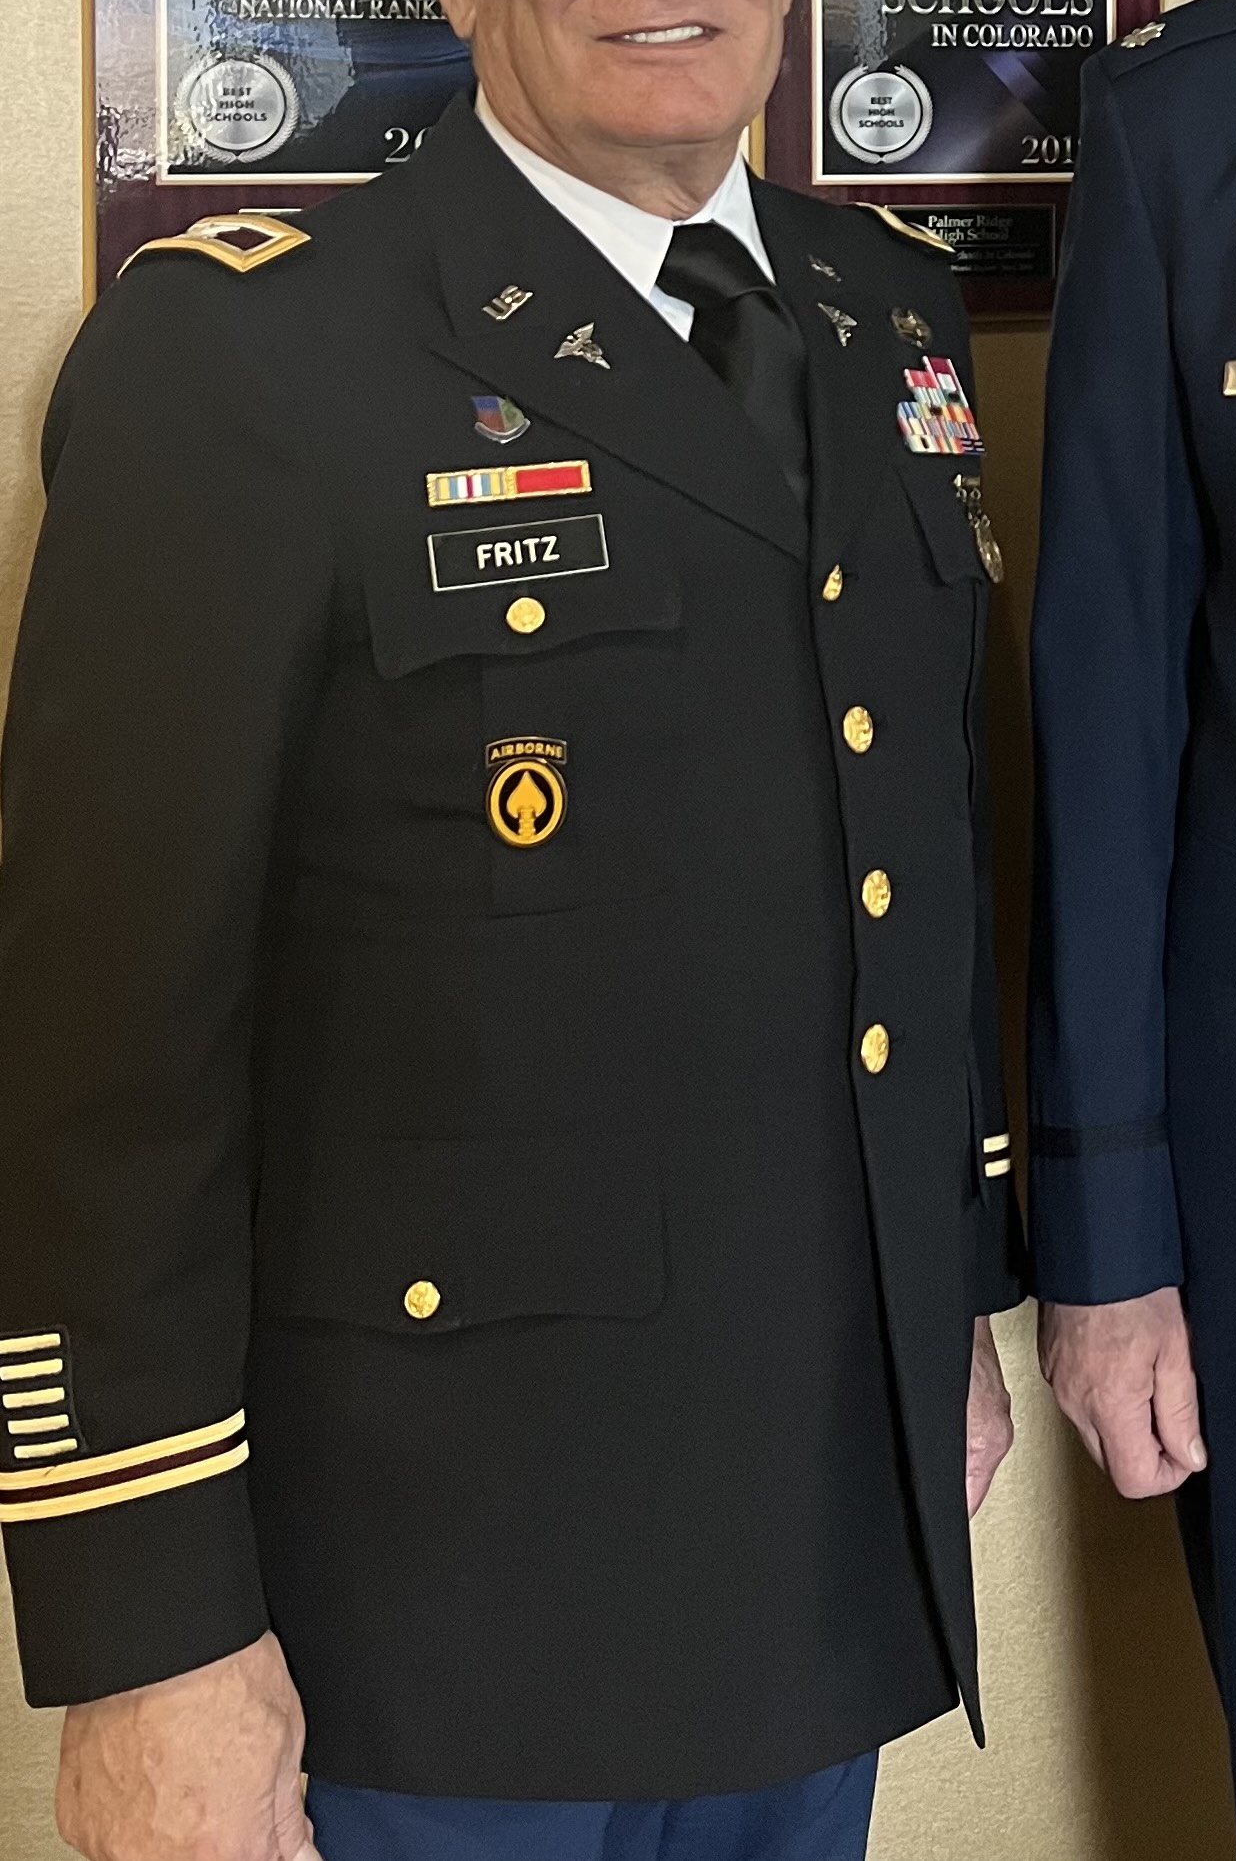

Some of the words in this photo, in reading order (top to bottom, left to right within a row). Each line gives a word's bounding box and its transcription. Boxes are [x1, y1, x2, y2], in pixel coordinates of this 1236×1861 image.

[931, 24, 959, 46] IN
[962, 24, 1094, 48] COLORADO
[222, 87, 252, 96] BEST
[868, 108, 895, 117] HIGH
[858, 119, 905, 128] SCHOOLS
[1020, 134, 1081, 165] 201
[928, 214, 974, 228] Palmer
[475, 535, 561, 571] FRITZ
[490, 741, 563, 761] AIRBORNE
